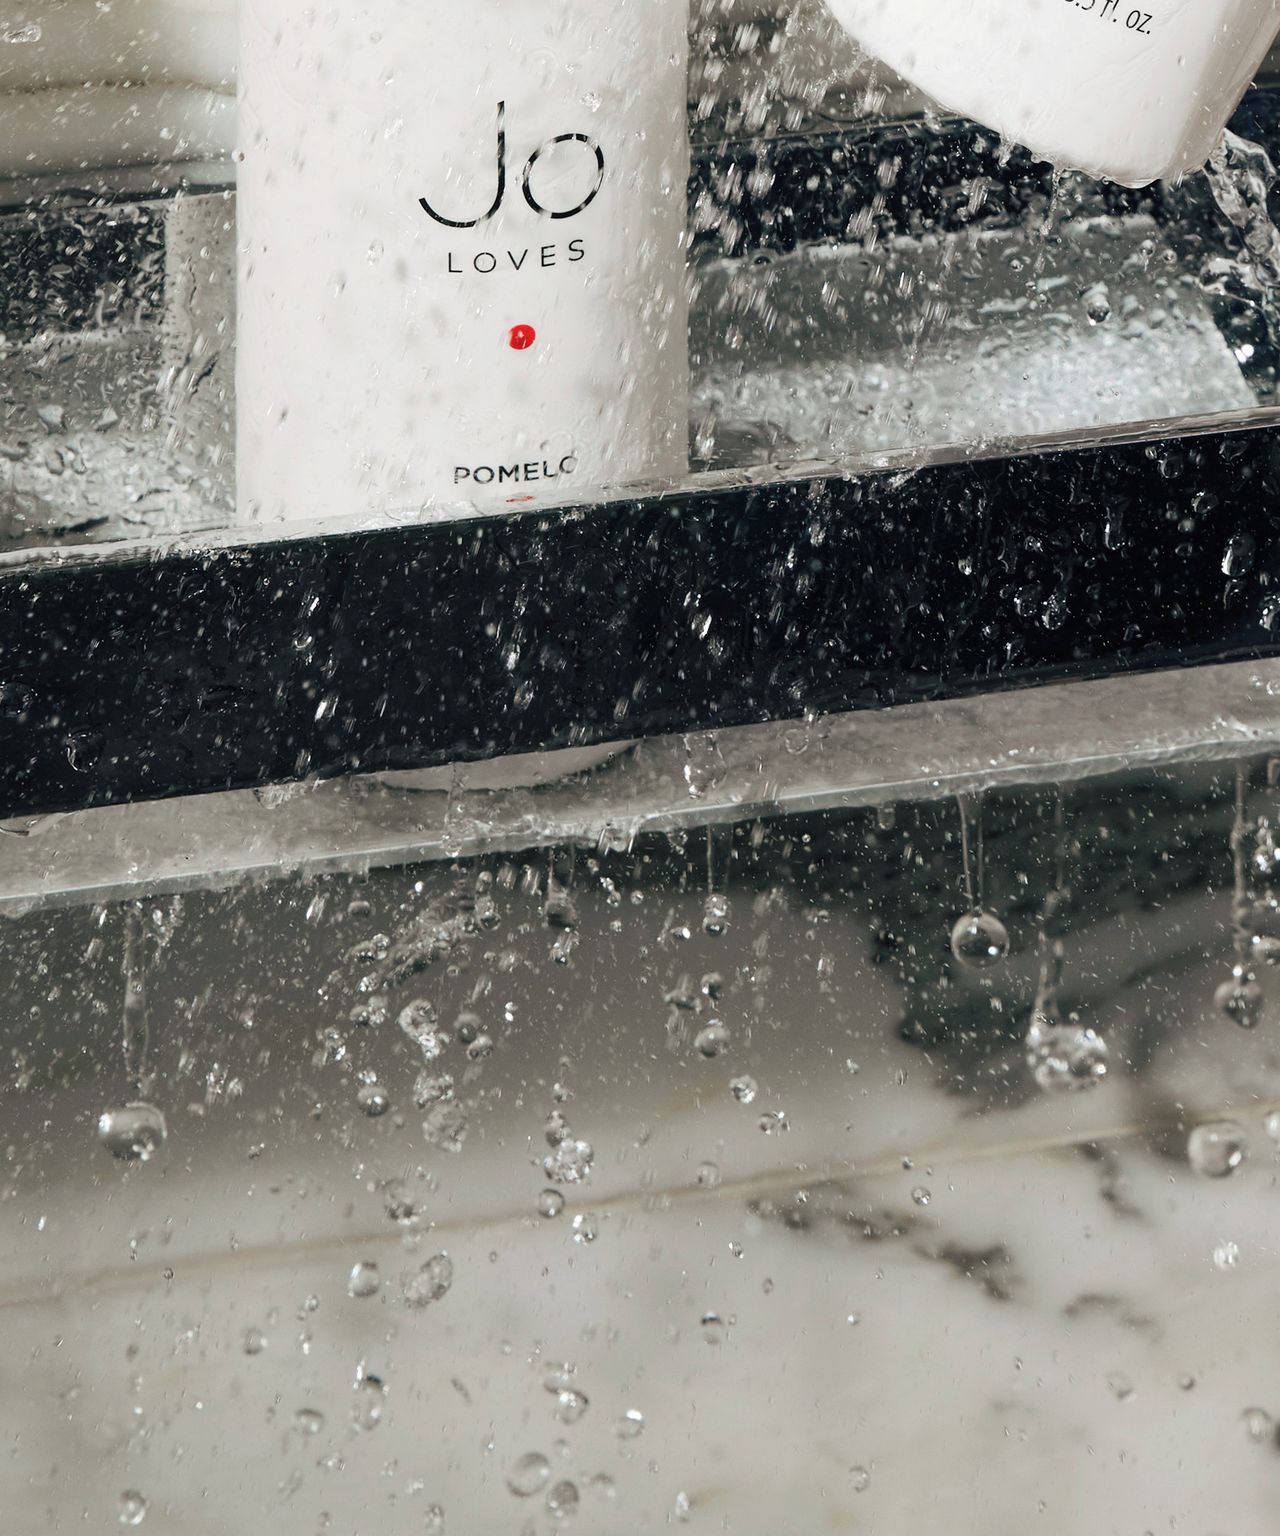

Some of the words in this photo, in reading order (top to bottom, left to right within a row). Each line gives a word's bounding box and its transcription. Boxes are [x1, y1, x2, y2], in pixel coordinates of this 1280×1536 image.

[1125, 10, 1153, 35] oz.
[419, 100, 604, 228] Jo
[448, 239, 586, 274] LOVES
[454, 455, 578, 484] POMELO
